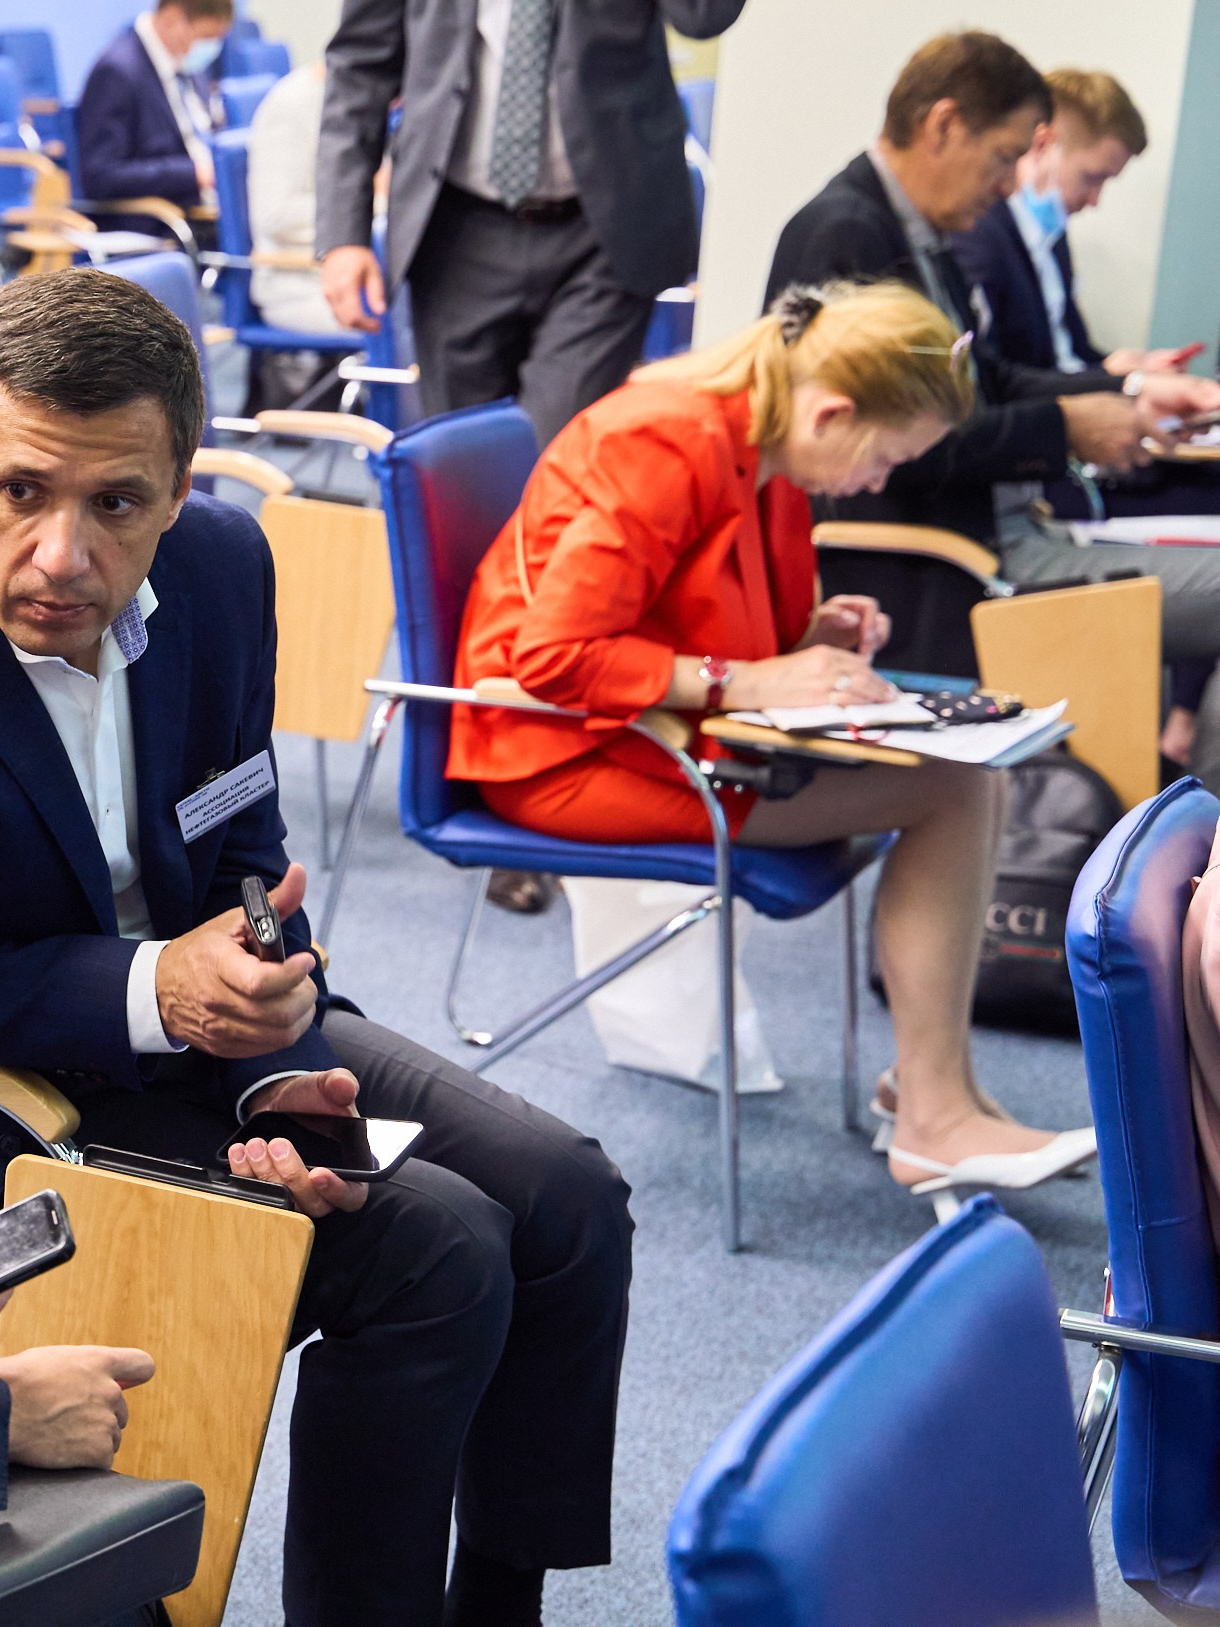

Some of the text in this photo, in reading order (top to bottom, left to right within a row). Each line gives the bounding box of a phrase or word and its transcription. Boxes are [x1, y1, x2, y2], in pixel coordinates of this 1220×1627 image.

[184, 788, 229, 819] АЛЕКСАНДР
[230, 767, 264, 791] САКЕВИЧ
[185, 798, 239, 835] НЕФТЕГАЗОВЫЙ
[240, 780, 270, 804] КЛАСТЕР
[202, 785, 250, 817] АССОЦИАЦИЯ
[985, 902, 1047, 936] CCI
